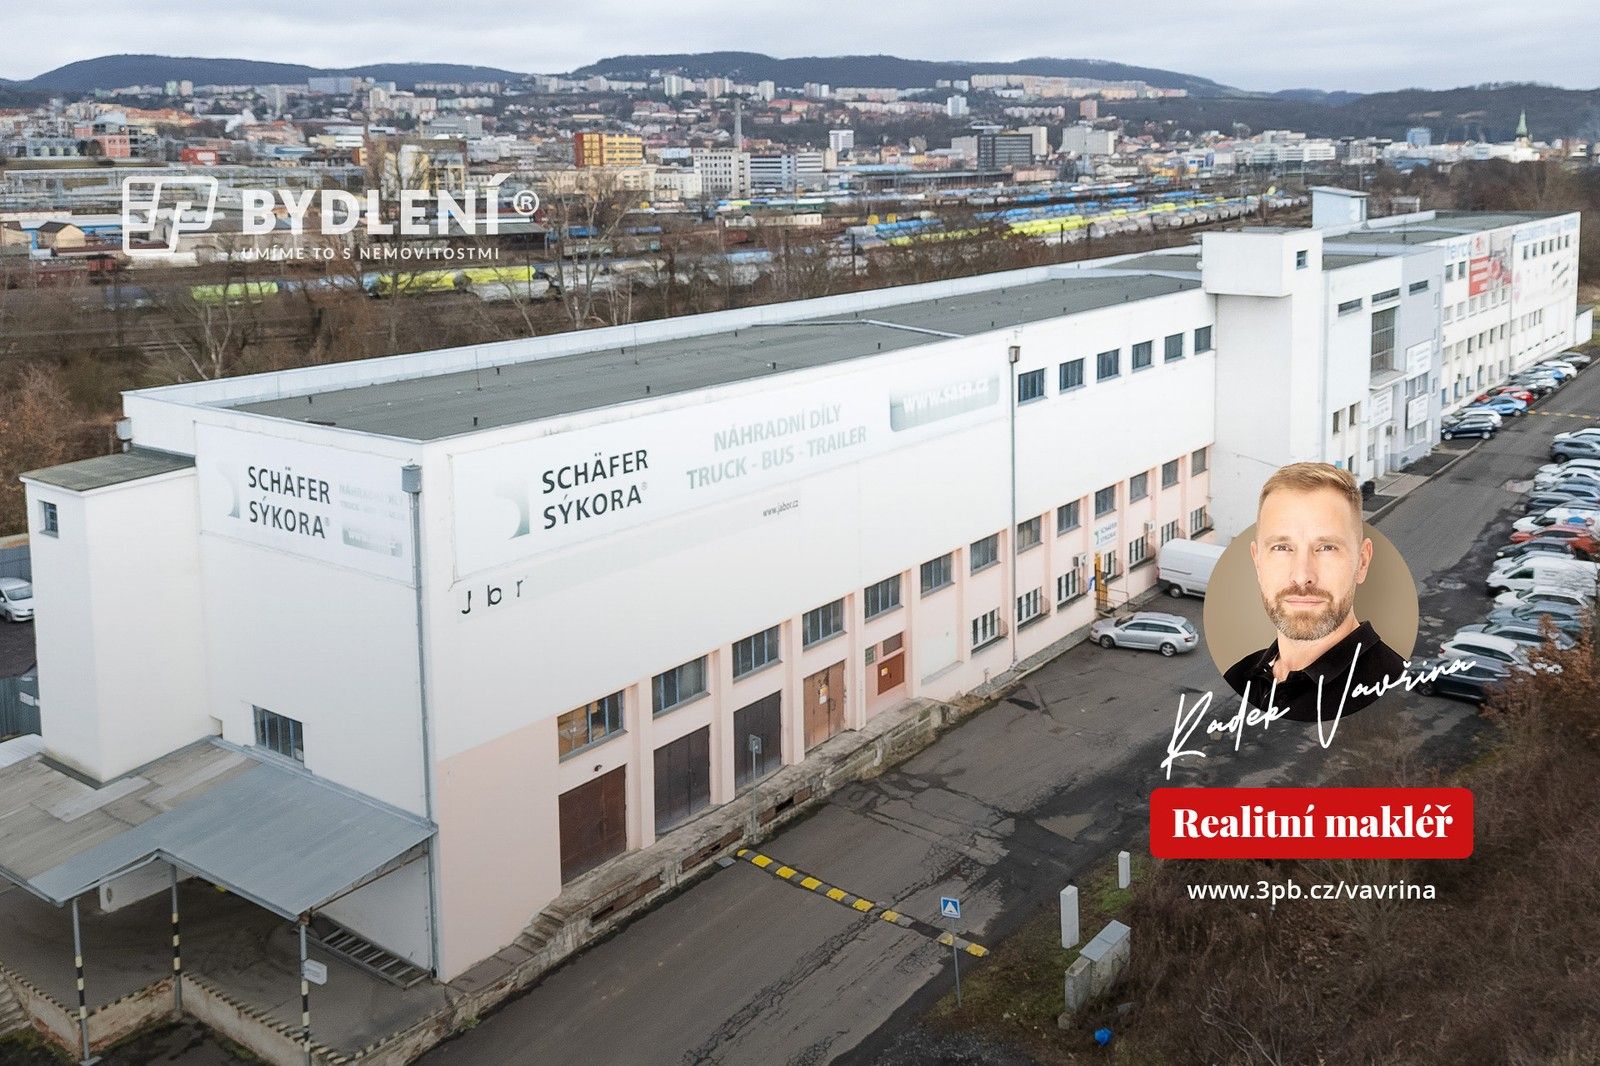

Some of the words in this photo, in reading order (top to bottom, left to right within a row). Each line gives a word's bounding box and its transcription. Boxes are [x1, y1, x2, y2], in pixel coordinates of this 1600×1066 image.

[713, 408, 805, 452] NÁHRADNÍ
[810, 401, 842, 430] DÍLY
[541, 449, 649, 495] SCHÄFER
[686, 456, 748, 490] TRUCK
[762, 445, 795, 471] BUS
[807, 425, 867, 458] TRAILER
[248, 465, 331, 504] SCHÄFER
